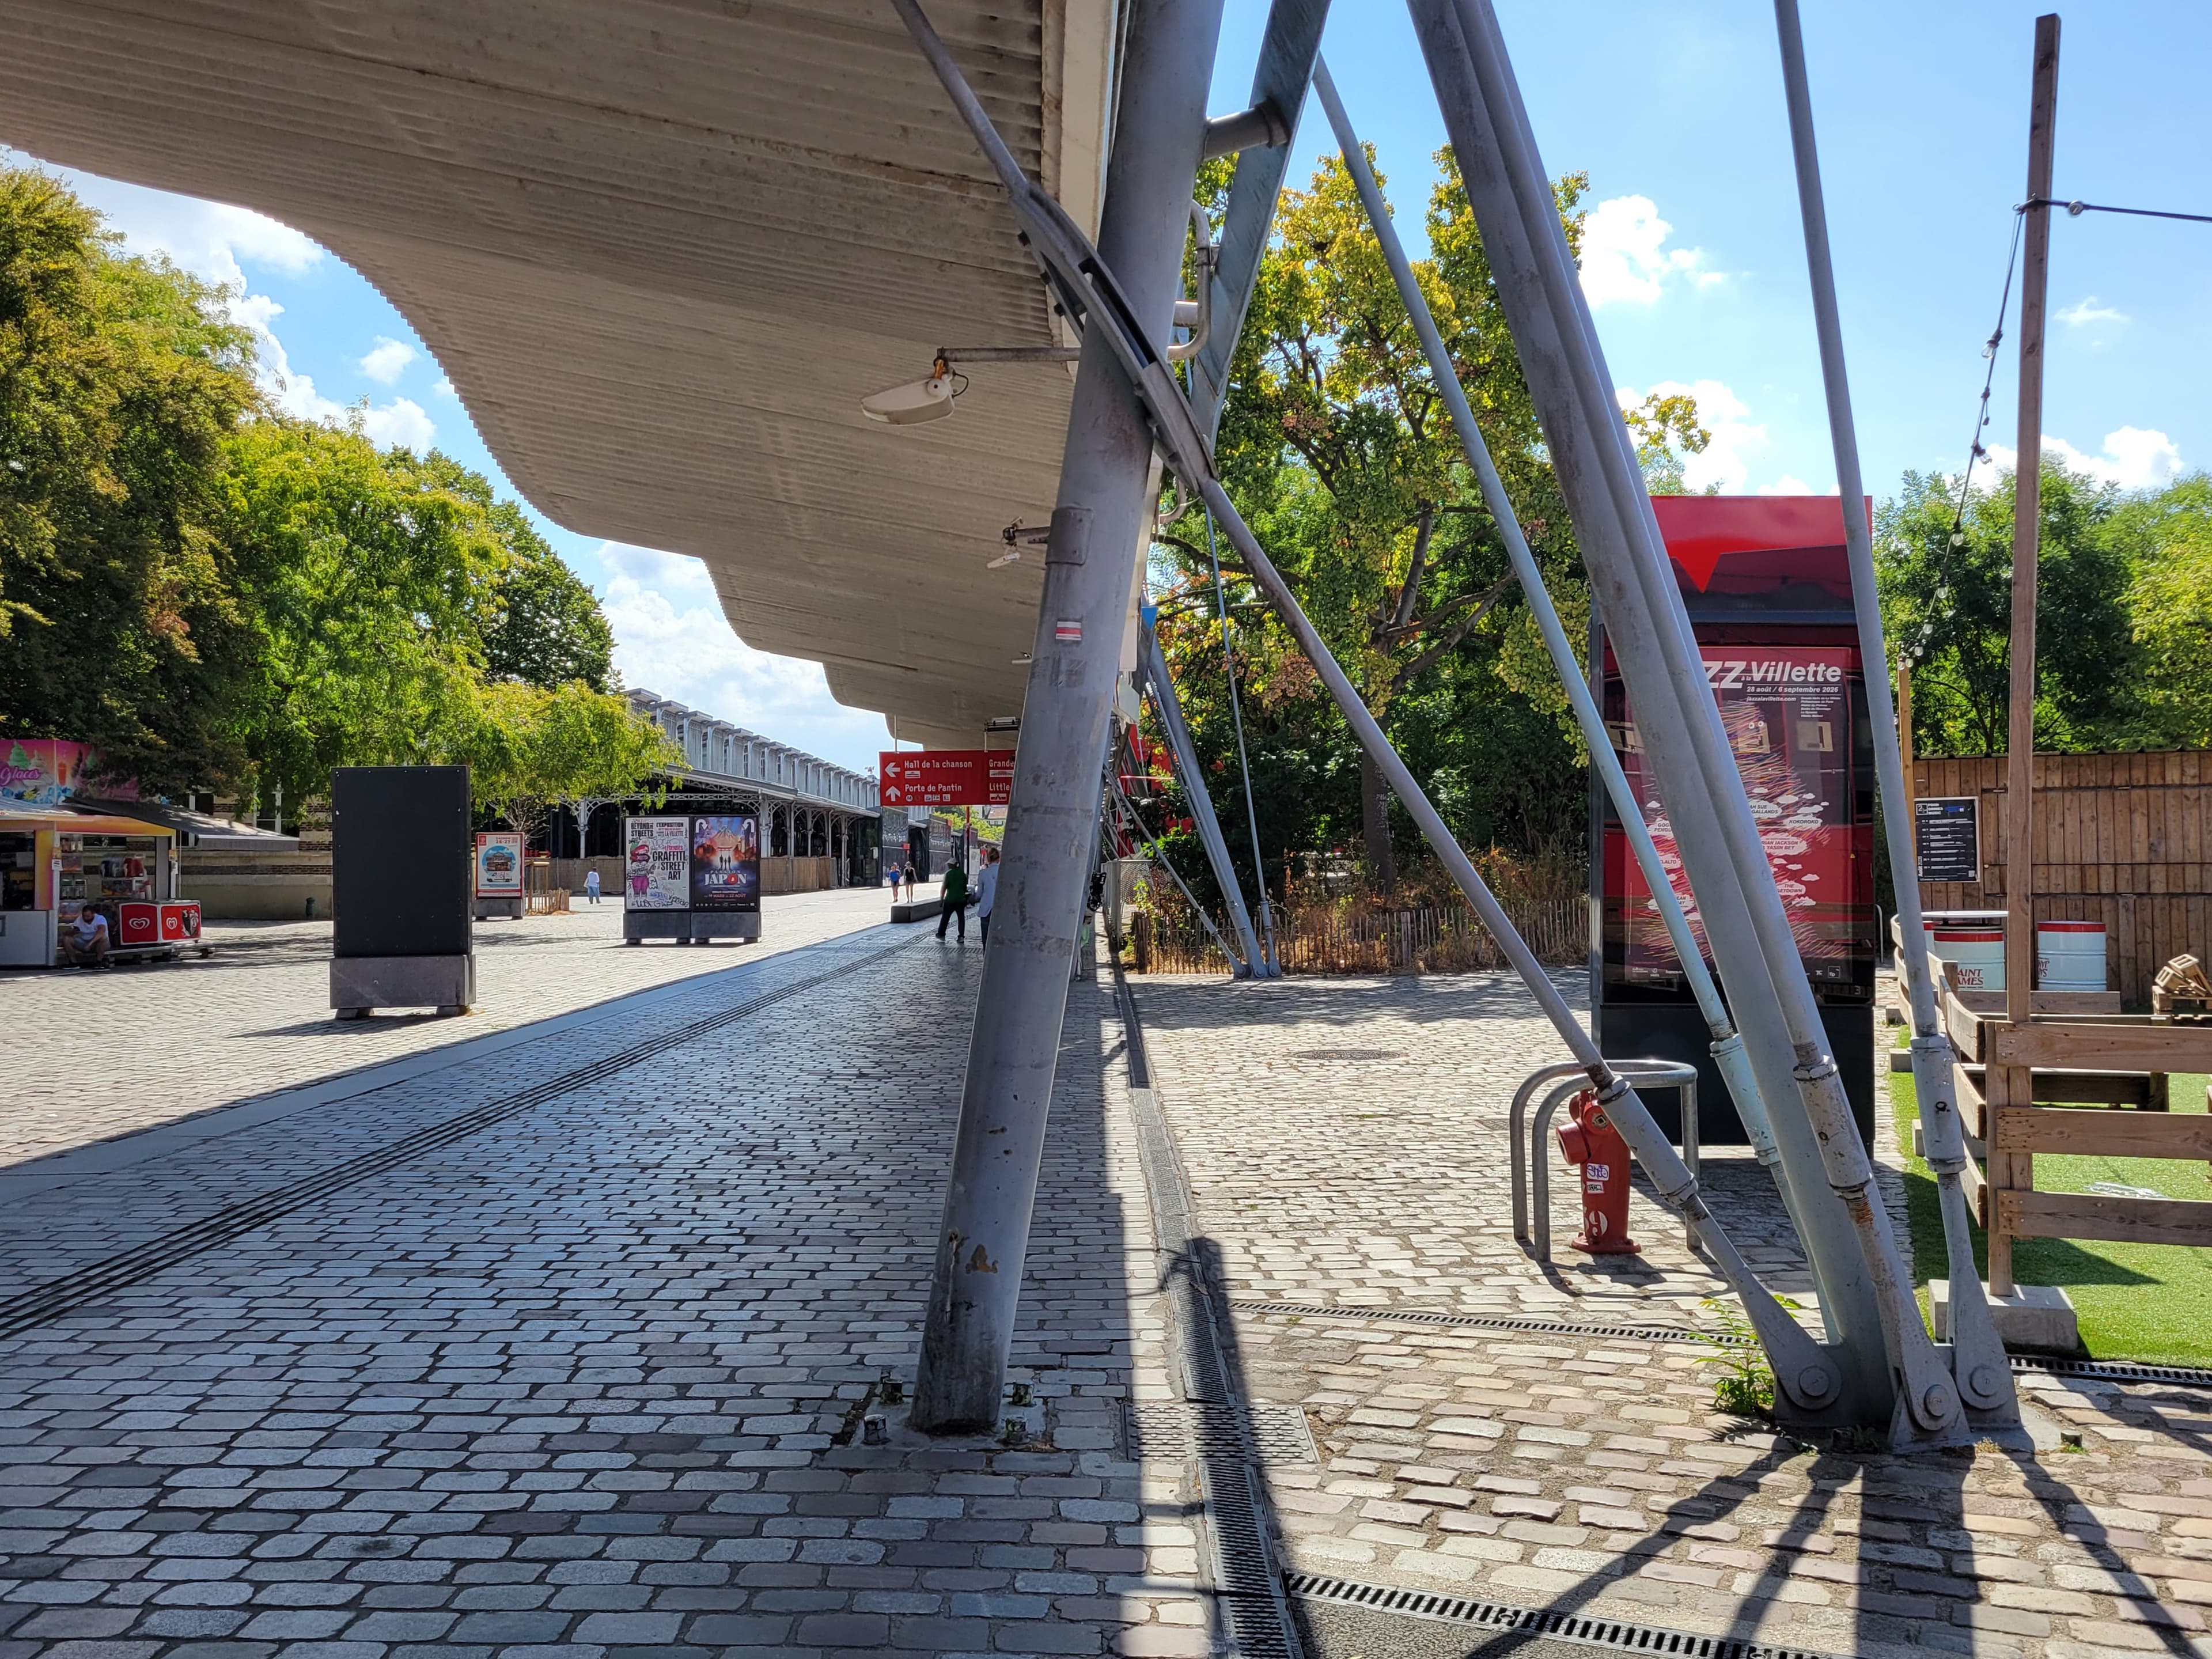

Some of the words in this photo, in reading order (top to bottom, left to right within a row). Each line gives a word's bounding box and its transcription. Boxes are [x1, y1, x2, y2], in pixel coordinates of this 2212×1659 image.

[1703, 661, 1747, 689] ZZ
[1751, 661, 1842, 682] Villette
[1784, 686, 1820, 694] septembre
[904, 760, 919, 768] Hall
[932, 760, 940, 768] la
[942, 760, 972, 768] chanson
[989, 759, 1014, 767] Grande
[1, 766, 40, 786] Glaces
[905, 784, 925, 792] Porte
[927, 784, 936, 792] de
[938, 783, 962, 791] Pantin
[989, 783, 1010, 791] Little
[661, 861, 685, 870] STREET
[668, 871, 681, 880] ART
[704, 873, 747, 885] JAPON
[1957, 969, 1983, 977] AINT
[1957, 978, 1984, 986] AMES
